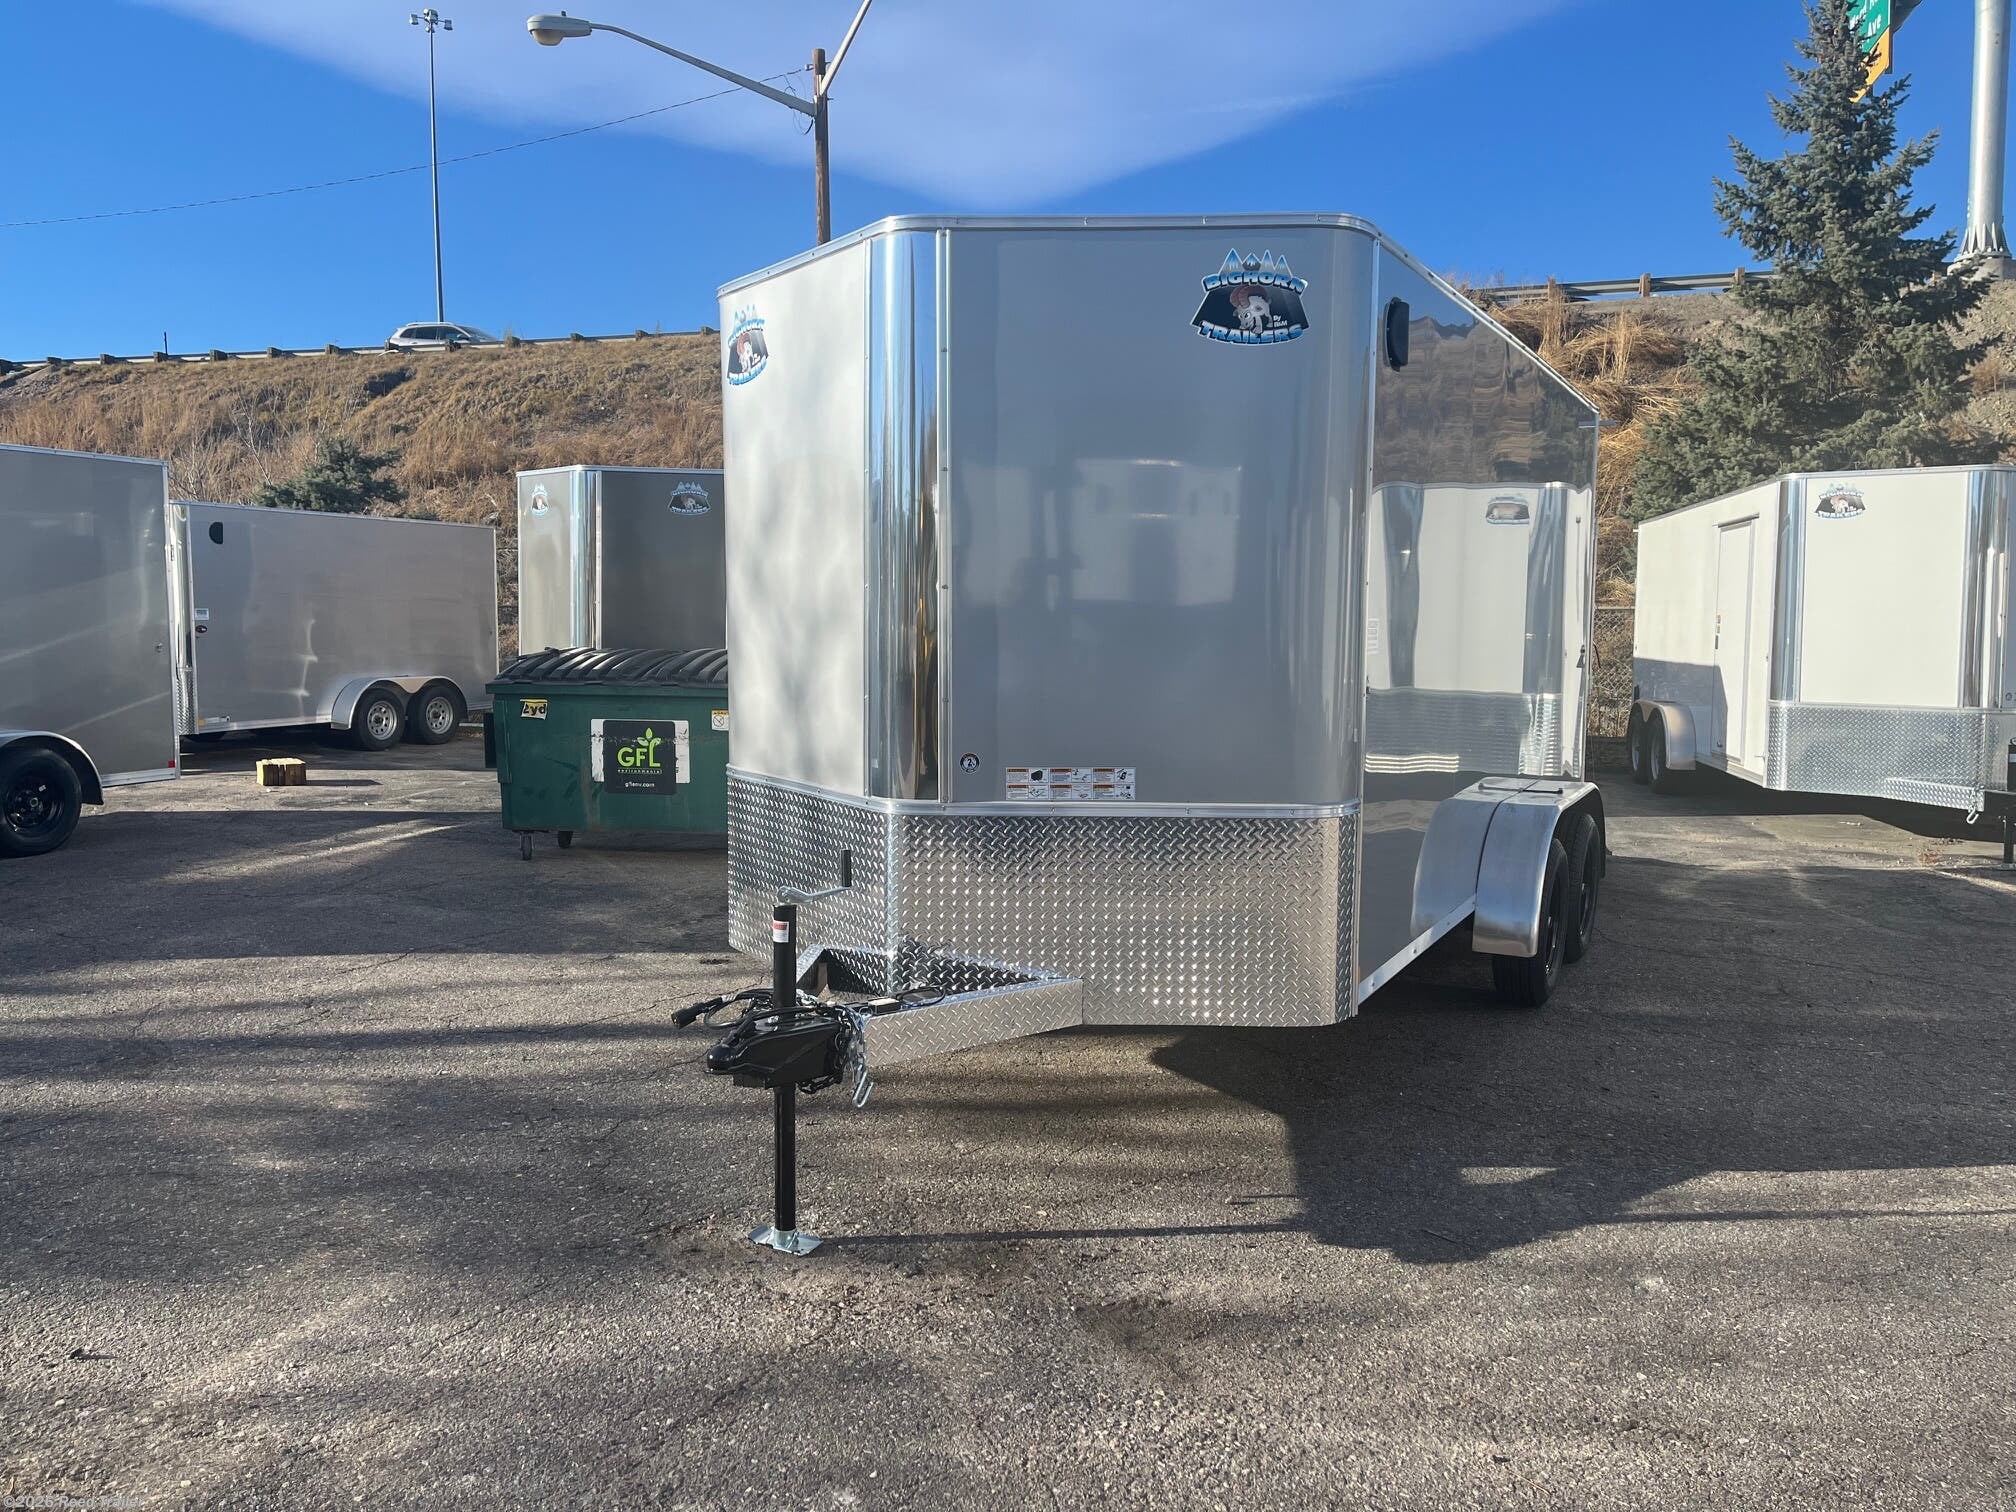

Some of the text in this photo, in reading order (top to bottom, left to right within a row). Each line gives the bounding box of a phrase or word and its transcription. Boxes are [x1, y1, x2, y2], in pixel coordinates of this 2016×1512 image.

[1204, 271, 1306, 294] BIGHORN
[1201, 320, 1304, 344] TRAILERS
[617, 739, 661, 767] GFL
